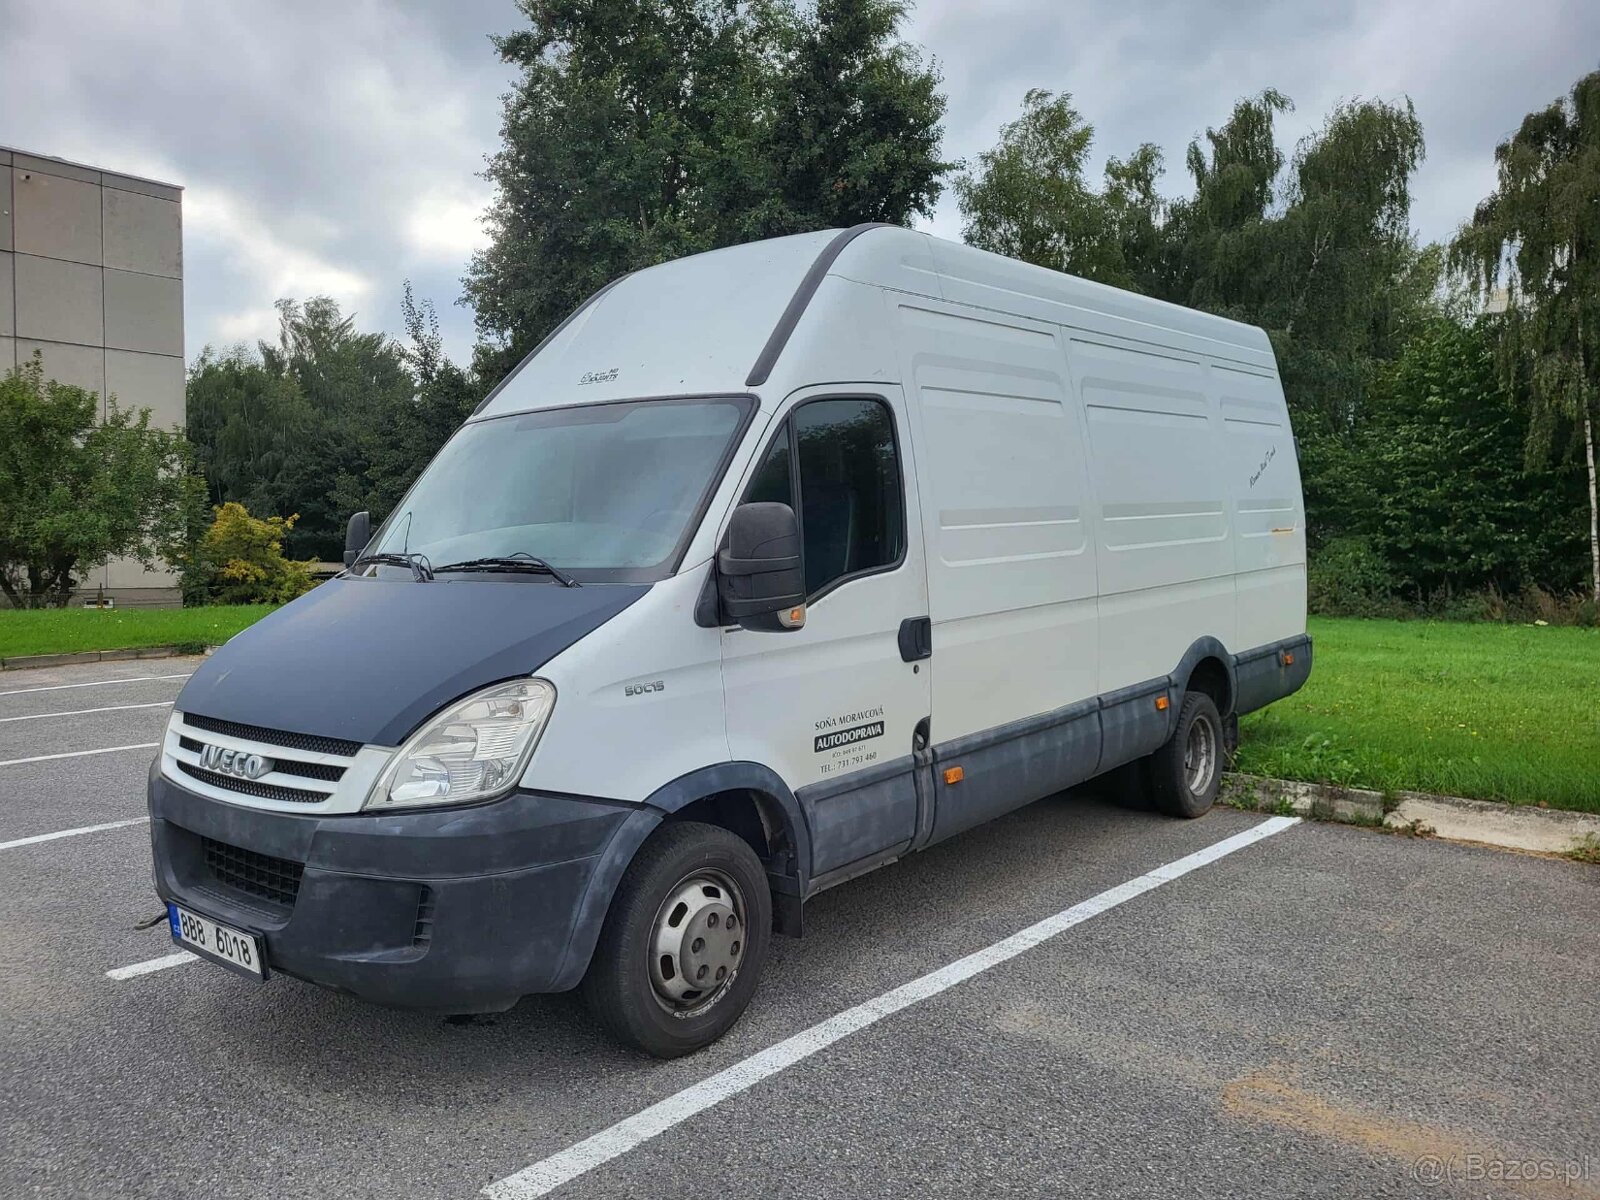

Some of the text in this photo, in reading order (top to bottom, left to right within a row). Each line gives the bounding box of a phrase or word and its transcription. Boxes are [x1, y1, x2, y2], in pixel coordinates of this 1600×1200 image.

[625, 680, 664, 697] 50C15
[816, 723, 882, 750] AUTODOPRAVA
[199, 744, 263, 779] IVECO
[181, 912, 251, 965] 8B8 6018
